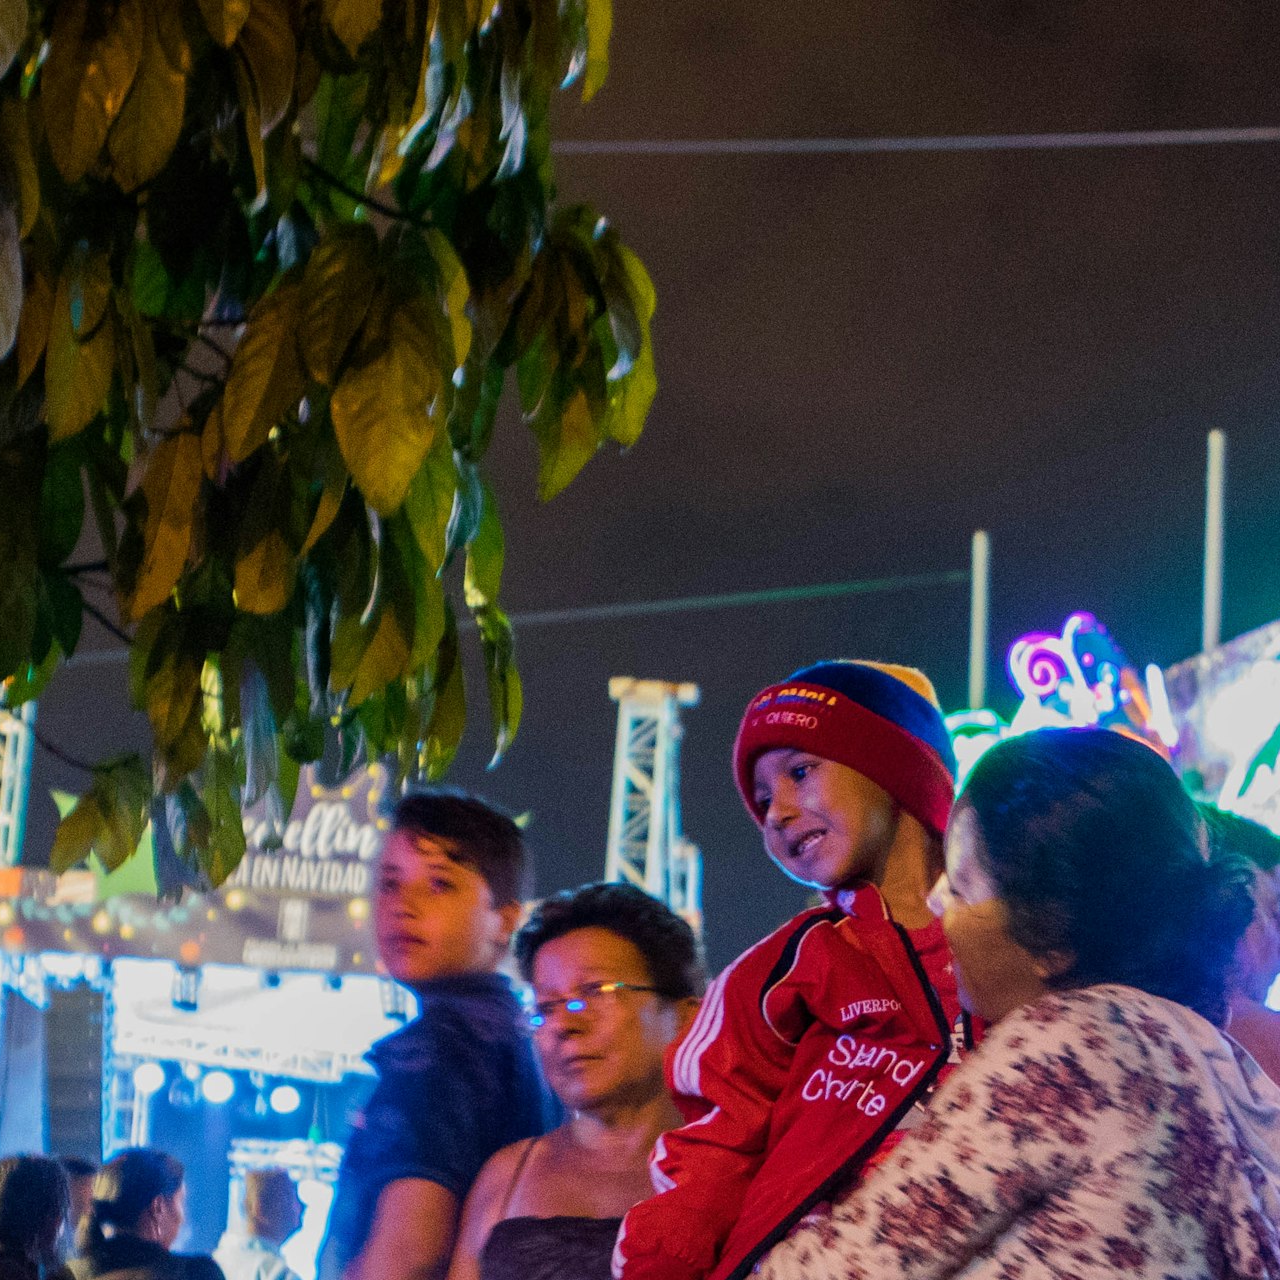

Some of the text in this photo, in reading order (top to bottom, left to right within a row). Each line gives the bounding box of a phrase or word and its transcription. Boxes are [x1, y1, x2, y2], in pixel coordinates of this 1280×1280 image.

[766, 711, 818, 729] QUIERO
[252, 855, 280, 889] EN
[281, 855, 368, 895] NAVIDAD
[839, 999, 902, 1022] LIVERPO
